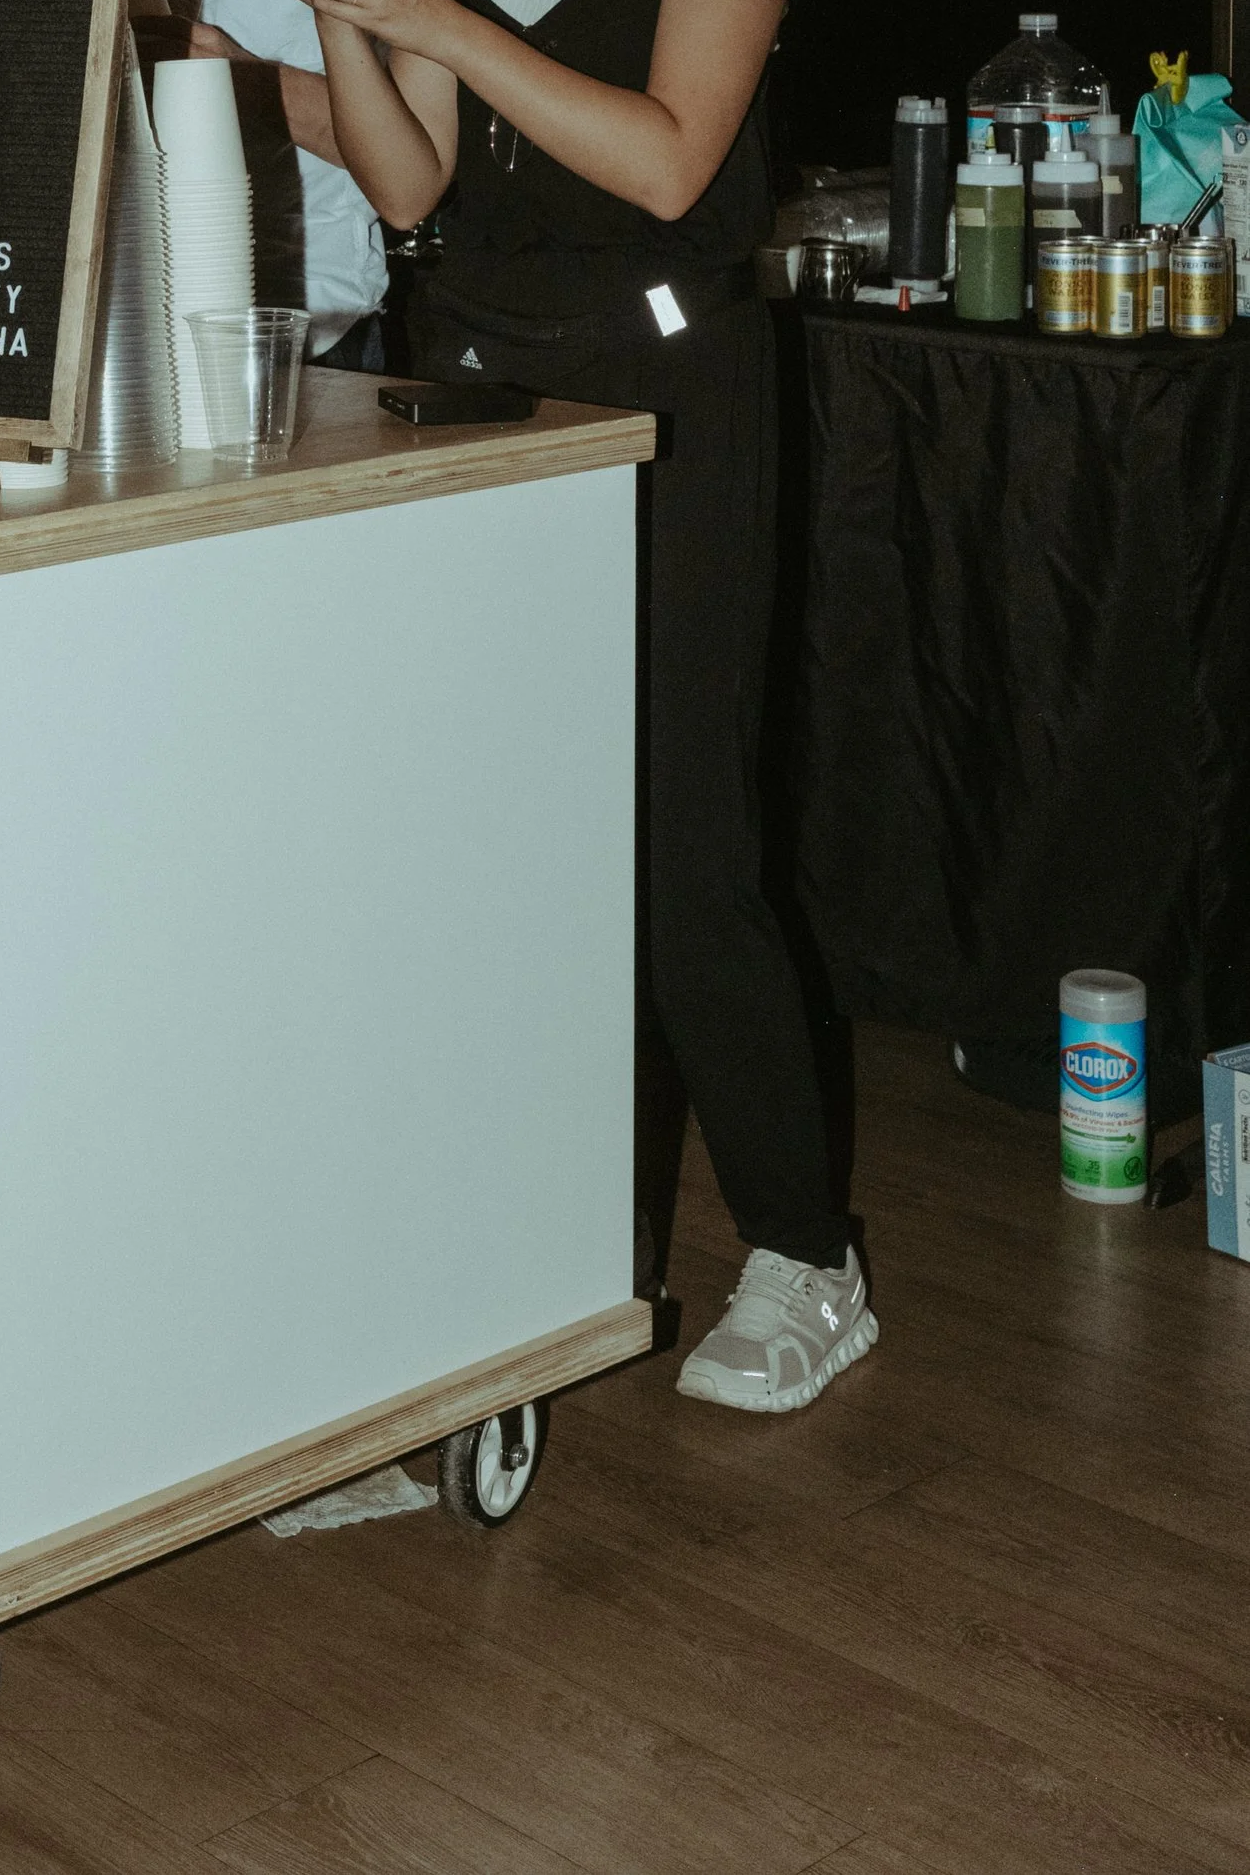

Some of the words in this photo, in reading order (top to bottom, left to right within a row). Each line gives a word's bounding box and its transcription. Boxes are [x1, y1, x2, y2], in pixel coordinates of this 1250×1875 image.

[459, 359, 483, 370] adidas
[1066, 1051, 1128, 1080] CLOROX
[1208, 1122, 1224, 1197] CALIFIA
